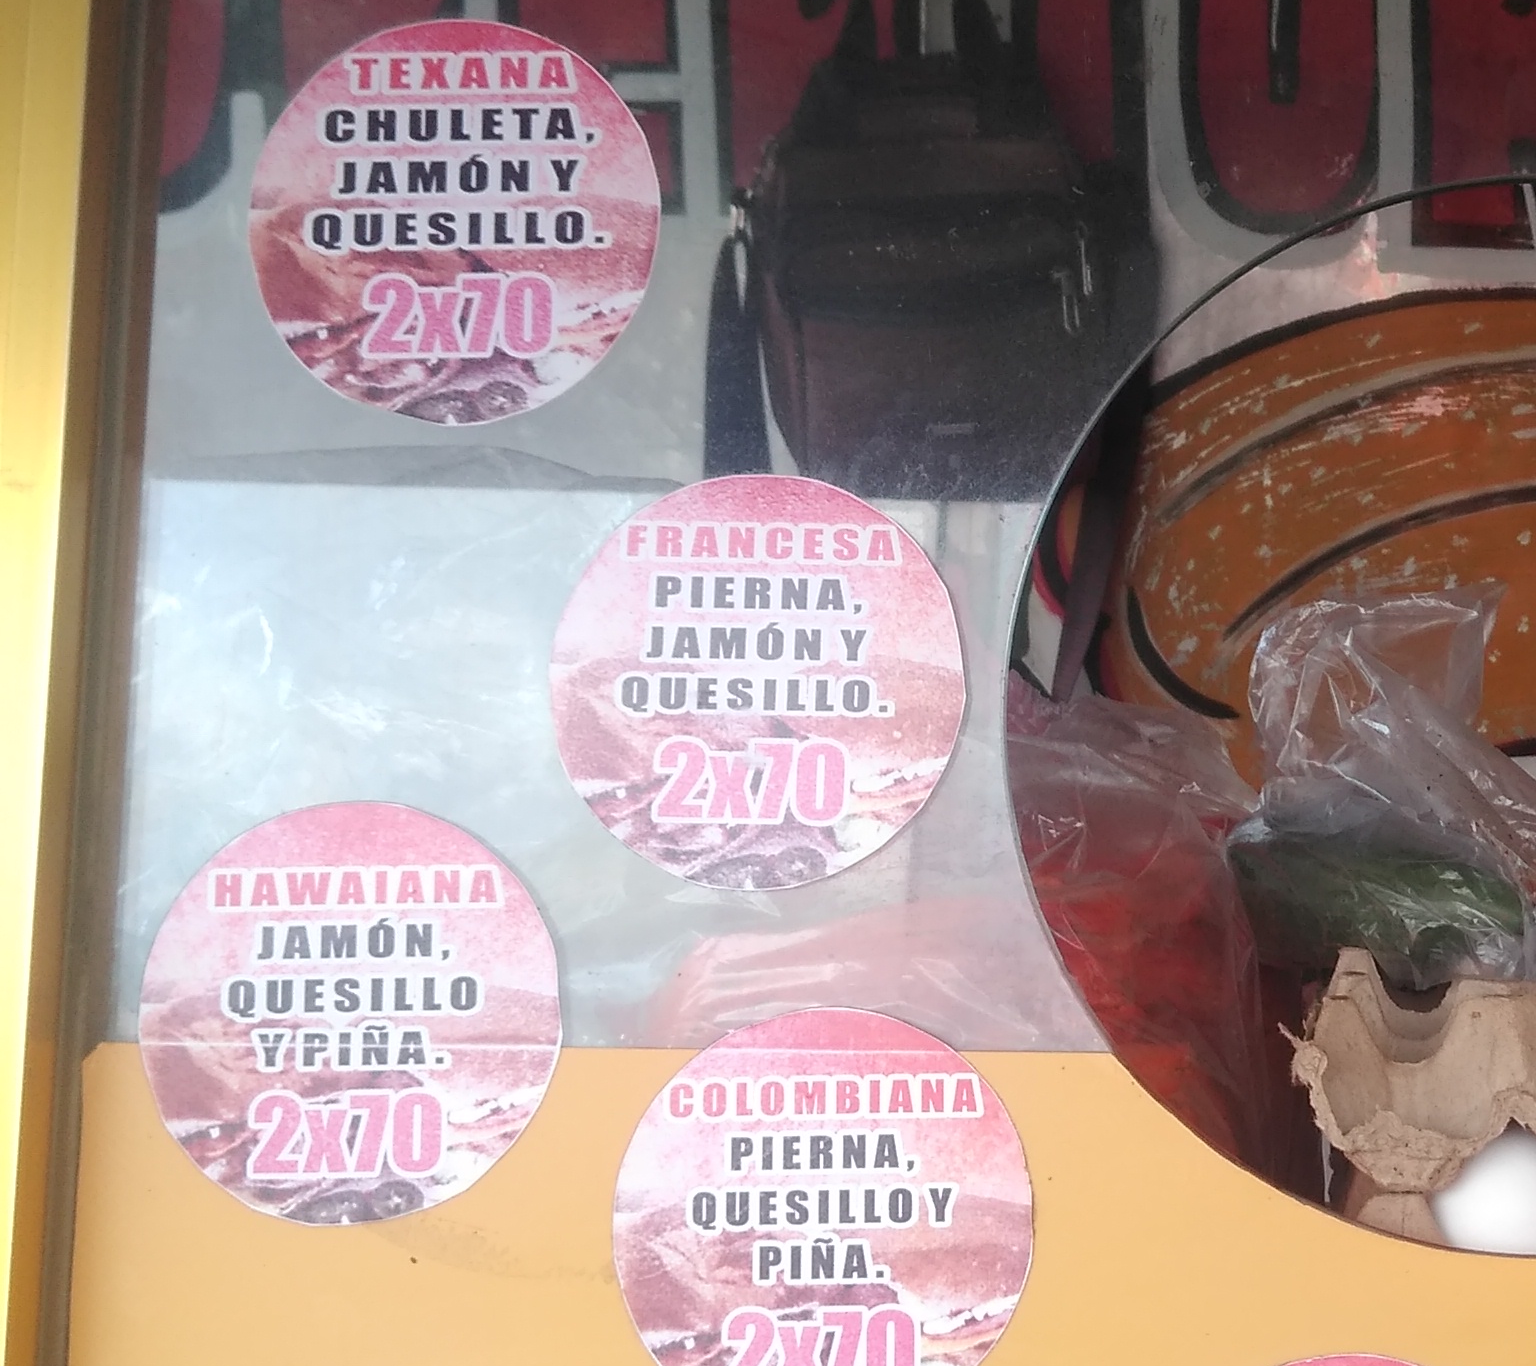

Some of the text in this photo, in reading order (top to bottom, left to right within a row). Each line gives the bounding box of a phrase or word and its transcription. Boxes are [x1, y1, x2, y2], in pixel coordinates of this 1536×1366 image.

[349, 55, 572, 93] TEXANA
[323, 106, 597, 146] CHULETA,
[335, 152, 582, 197] JAMÓN Y
[309, 210, 607, 251] QUESILLO.
[363, 274, 555, 357] 2x70
[624, 523, 898, 563] FRANCESA
[653, 573, 865, 617] PIERNA,
[644, 620, 870, 664] JAMÓN Y
[619, 674, 891, 715] QUESILLO.
[654, 738, 848, 823] 2x70
[212, 868, 500, 909] HAWAIANA
[255, 915, 453, 962] JAMÓN,
[225, 974, 481, 1020] QUESILLO
[255, 1023, 447, 1069] Y PIÑA.
[667, 1076, 980, 1120] COLOMBIANA
[251, 1092, 443, 1176] 2x70
[728, 1132, 917, 1174] PIERNA,
[689, 1186, 955, 1232] QUESILLO Y
[756, 1235, 886, 1283] PIÑA.
